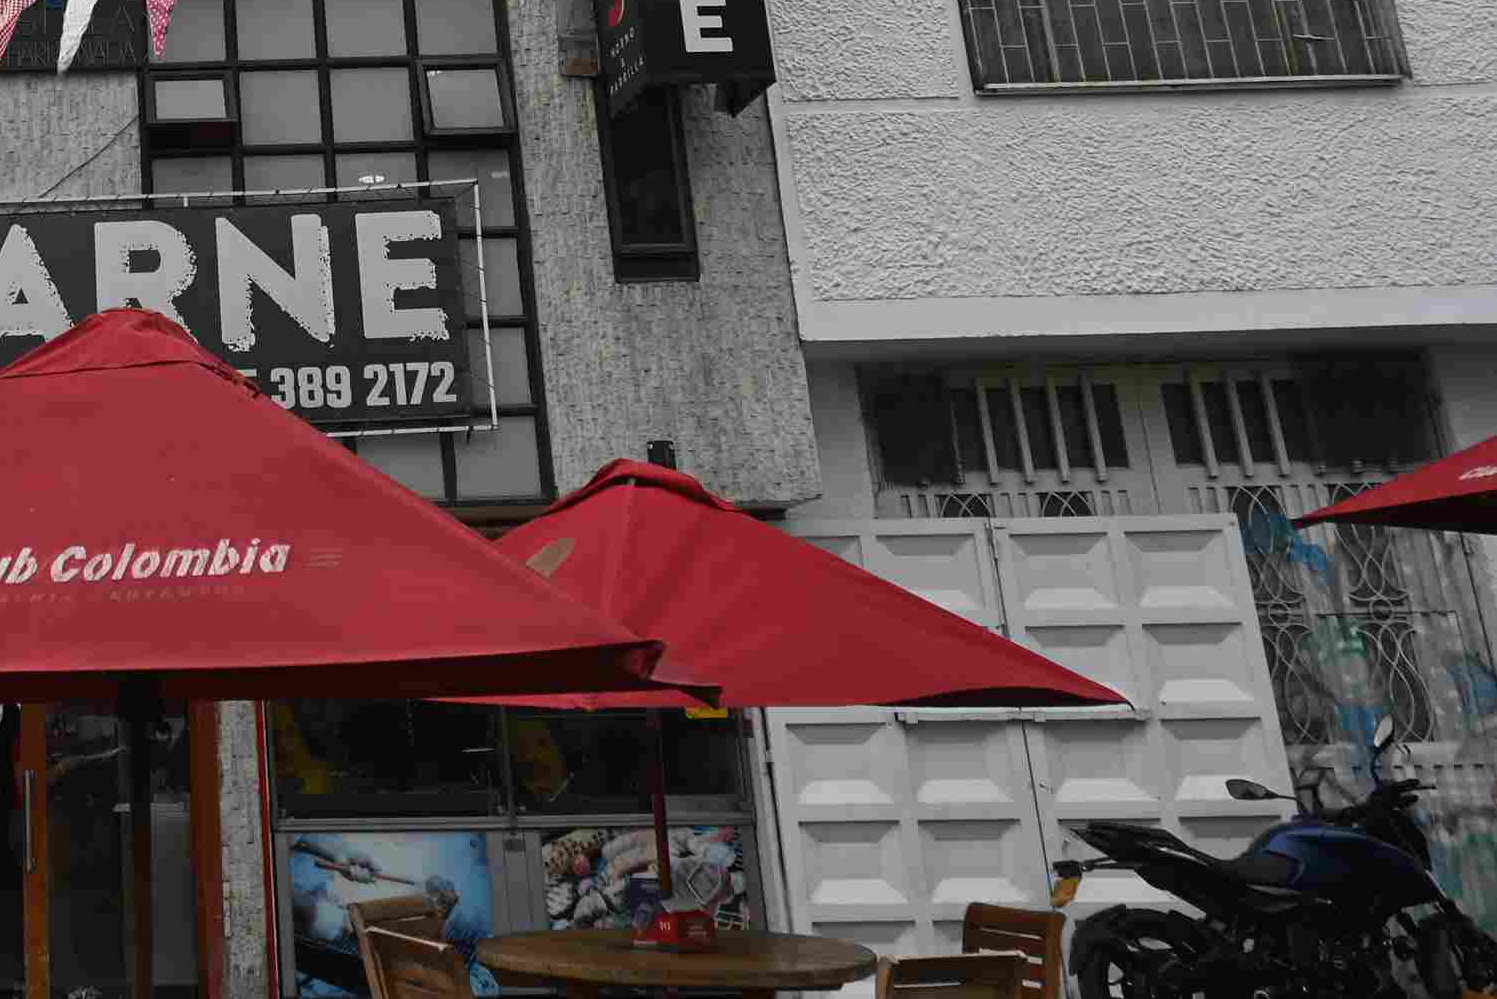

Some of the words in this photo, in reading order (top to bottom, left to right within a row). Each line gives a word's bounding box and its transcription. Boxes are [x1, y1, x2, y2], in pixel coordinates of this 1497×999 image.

[270, 366, 352, 410] 389
[363, 361, 457, 407] 2172
[50, 537, 291, 583] Colombia
